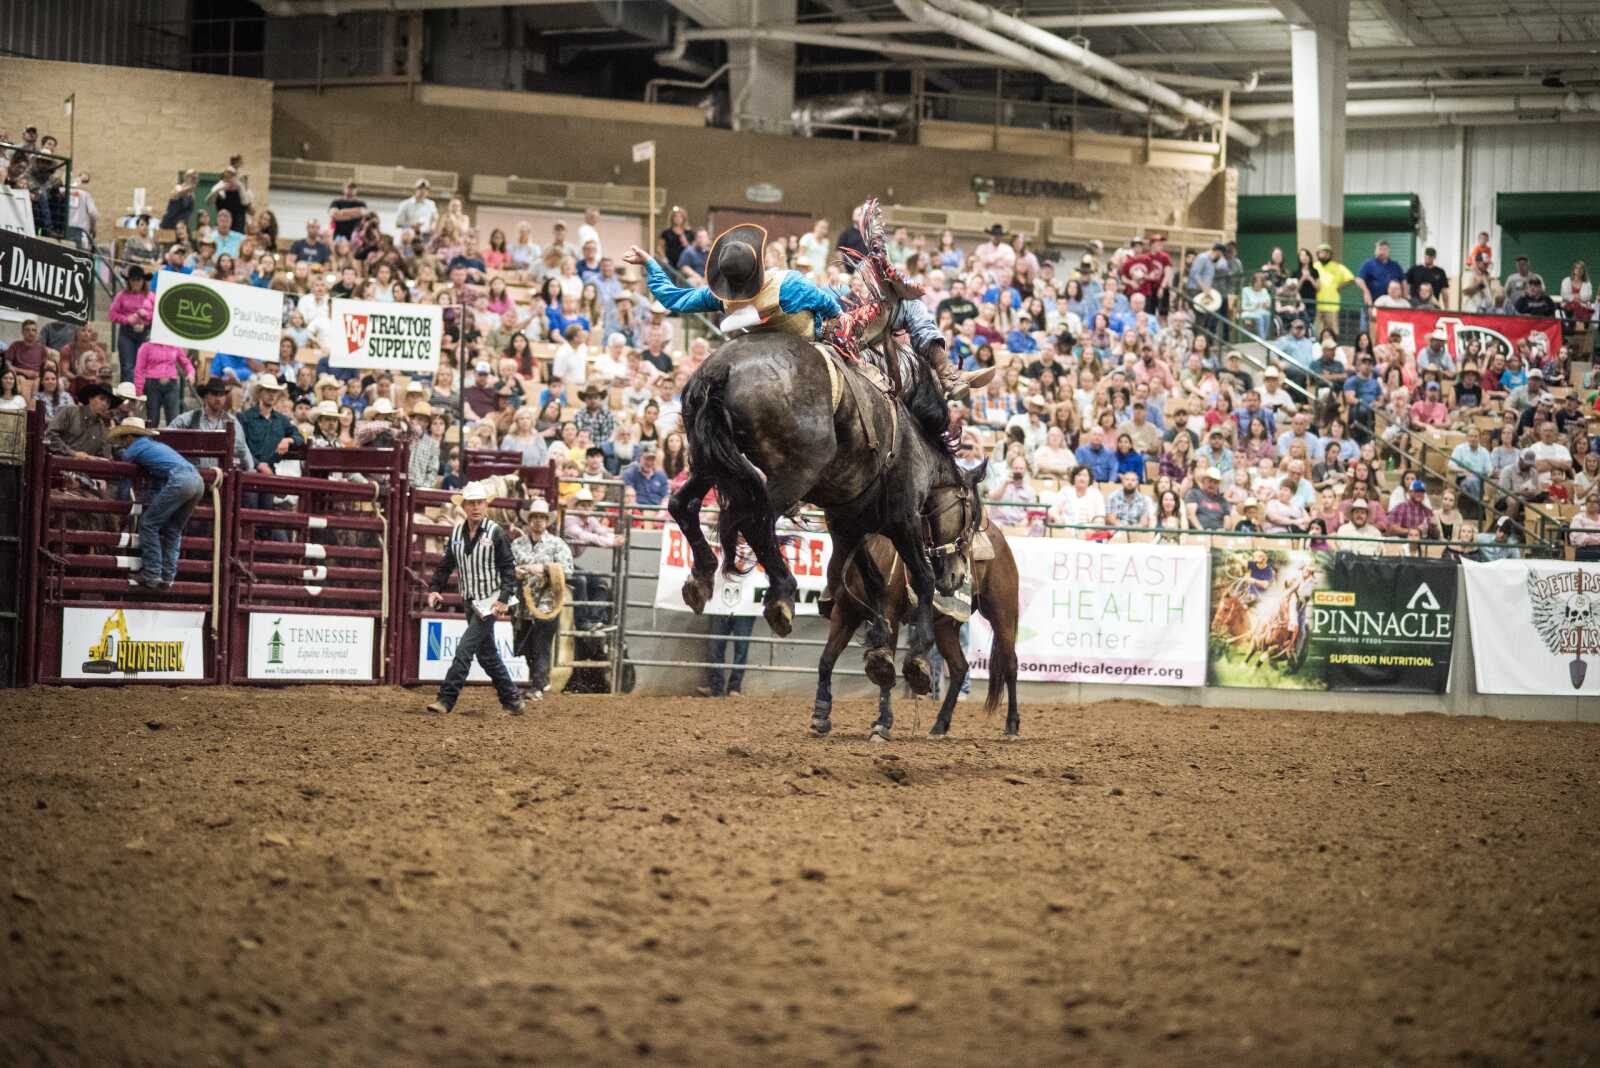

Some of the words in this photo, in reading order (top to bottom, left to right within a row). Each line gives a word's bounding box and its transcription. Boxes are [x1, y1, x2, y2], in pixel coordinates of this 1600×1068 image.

[9, 246, 85, 303] DANIEL'S
[177, 298, 213, 319] PVC
[233, 307, 251, 321] Paul
[369, 314, 431, 337] TRACTOR
[368, 337, 416, 359] SUPPLY
[1051, 550, 1185, 587] BREAST
[1051, 589, 1185, 625] HEALTH
[1312, 608, 1452, 639] PINNACLE
[288, 627, 359, 645] TENNESSEE
[1051, 626, 1132, 649] center
[1560, 628, 1600, 649] SONS
[322, 647, 349, 661] Hospital
[1329, 654, 1377, 665] SUPERIOR
[1379, 655, 1434, 667] NUTRITION.
